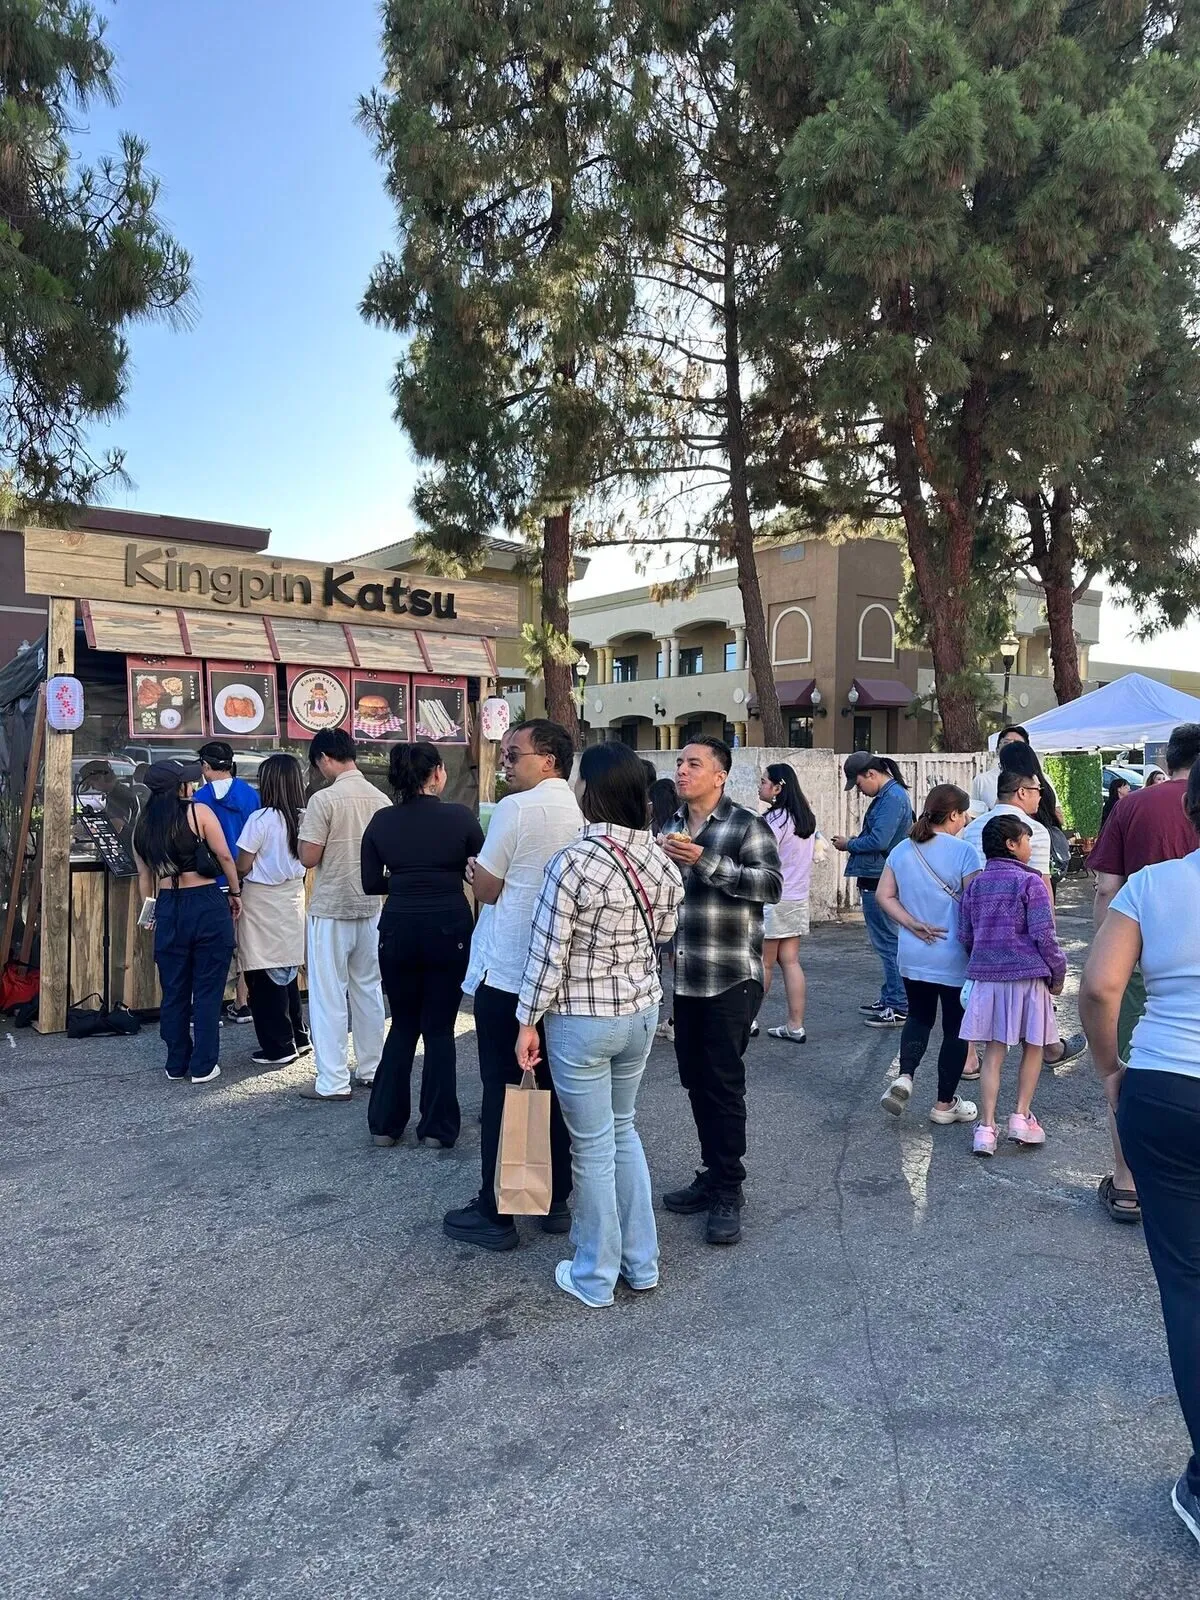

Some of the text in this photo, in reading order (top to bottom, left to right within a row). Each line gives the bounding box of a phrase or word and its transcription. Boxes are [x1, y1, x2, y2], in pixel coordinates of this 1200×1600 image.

[126, 543, 457, 619] Kingpin Katsu
[301, 676, 337, 691] Kingpin Katsu
